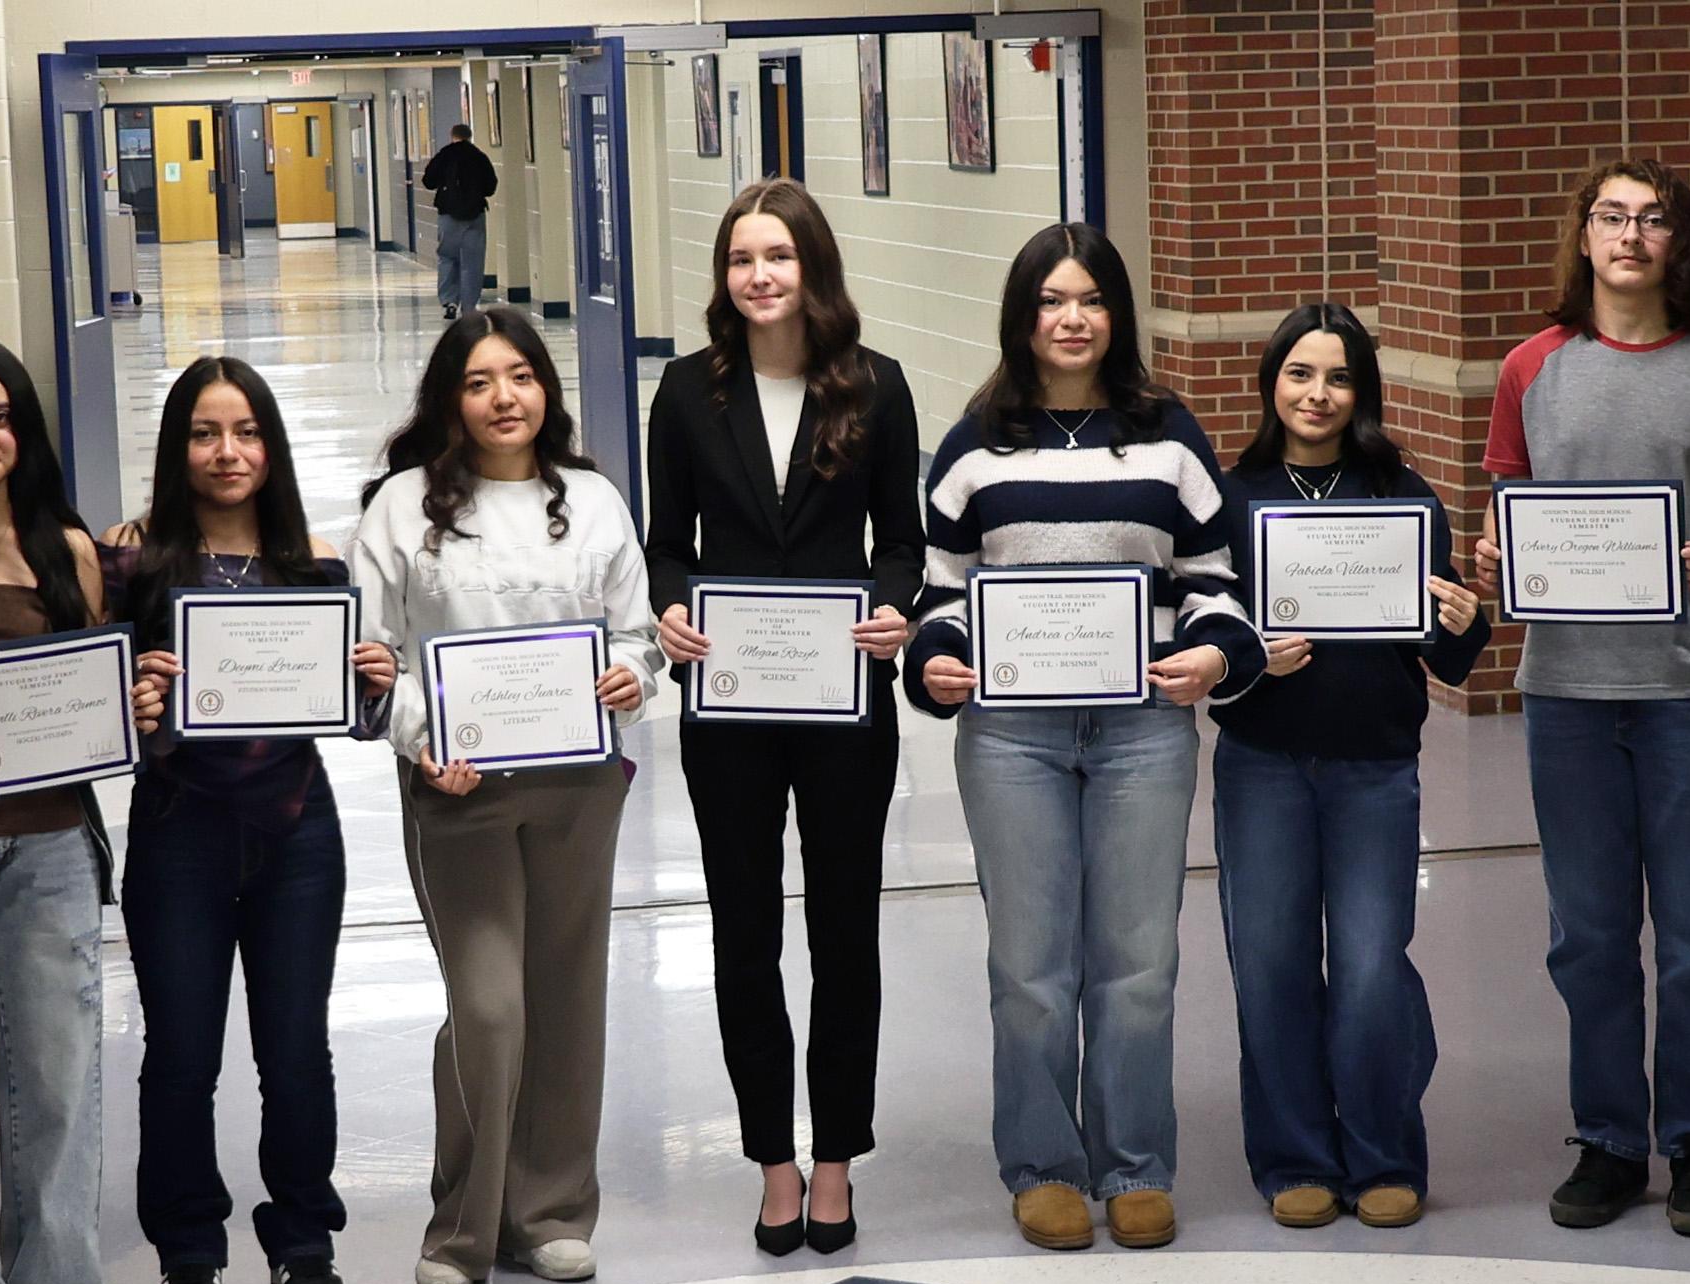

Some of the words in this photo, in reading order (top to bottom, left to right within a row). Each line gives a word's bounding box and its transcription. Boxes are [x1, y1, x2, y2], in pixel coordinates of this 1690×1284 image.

[1520, 539, 1557, 553] Avery
[1602, 540, 1657, 552] Williams
[1285, 562, 1332, 576] Fabiola
[1335, 561, 1402, 575] Villarreal
[1005, 626, 1060, 641] Andrea
[1064, 624, 1113, 640] Juarez
[737, 644, 778, 659] Megan
[761, 673, 796, 681] SCIENCE
[470, 688, 520, 703] Ashley
[523, 683, 572, 700] Juarez
[503, 715, 540, 724] LITERACY
